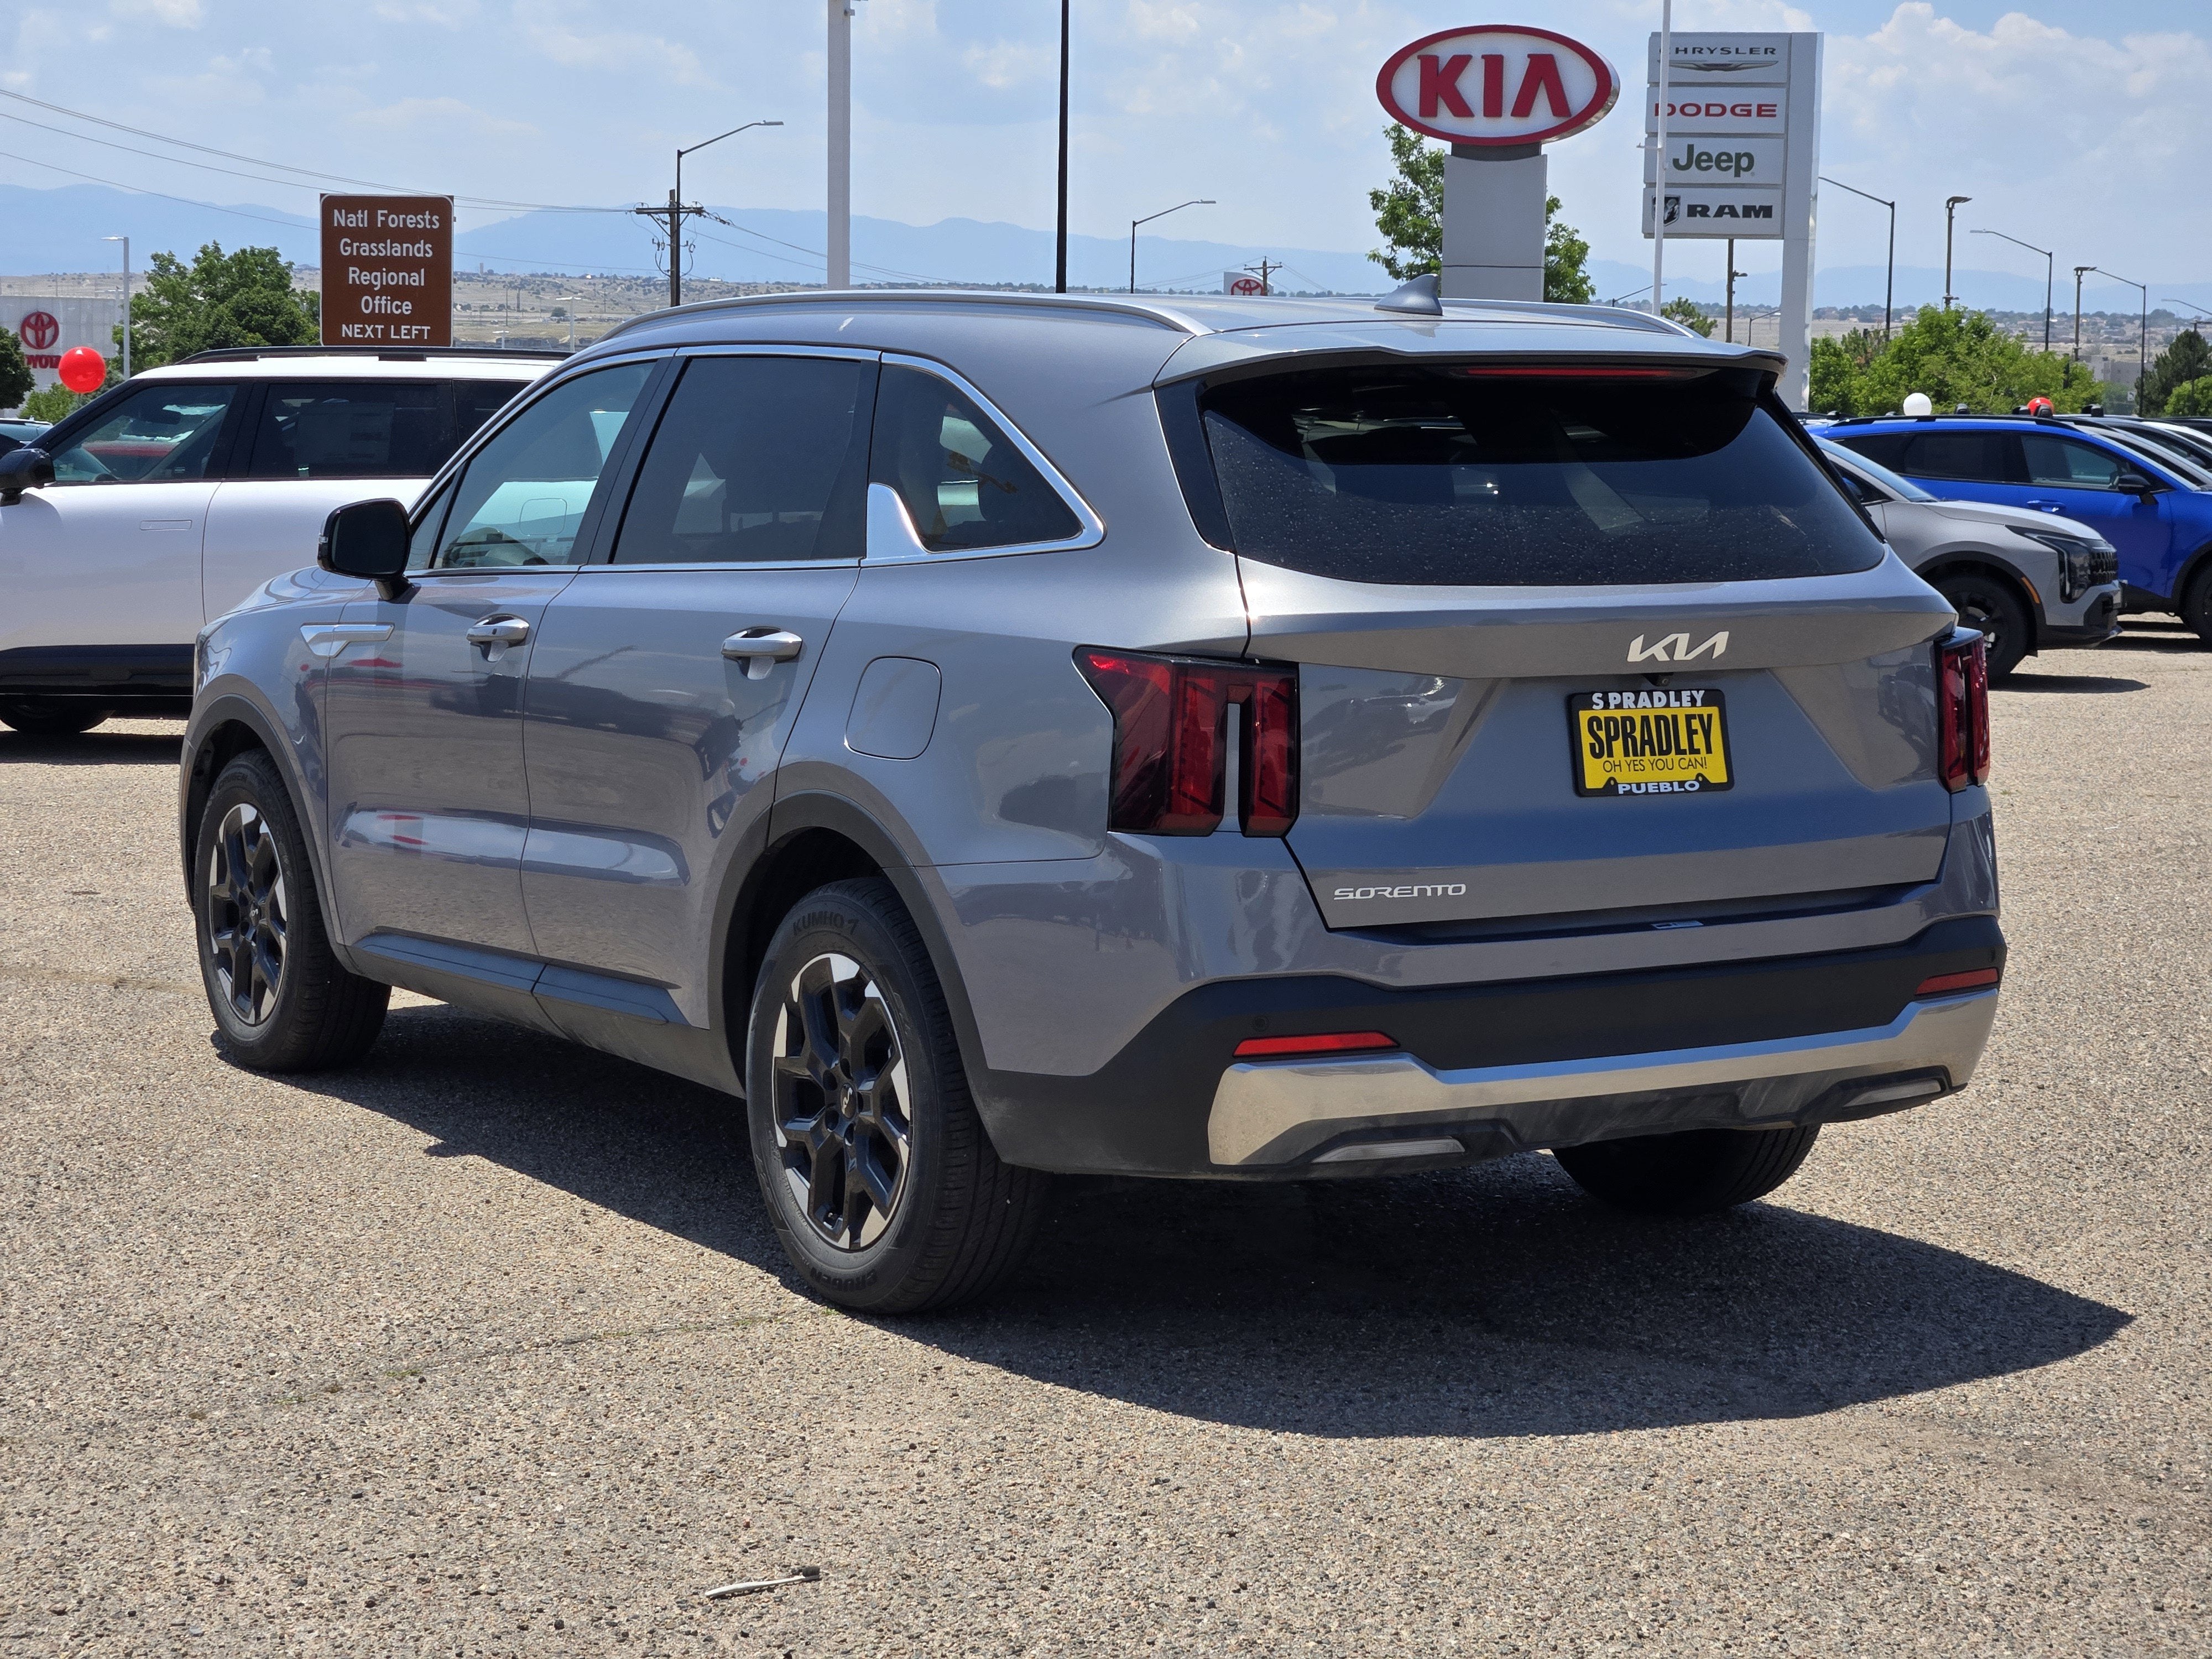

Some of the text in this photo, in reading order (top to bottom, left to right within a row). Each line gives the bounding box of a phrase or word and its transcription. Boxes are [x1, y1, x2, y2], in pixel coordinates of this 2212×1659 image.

[1659, 46, 1776, 55] HRYSLER
[1417, 53, 1572, 118] KIA
[1654, 103, 1777, 117] DODGE
[1672, 144, 1754, 178] Jeep
[333, 209, 440, 229] Natl Forests
[1687, 204, 1772, 218] RAM
[340, 238, 433, 257] Grasslands
[348, 267, 425, 290] Regional
[361, 295, 412, 315] Office
[342, 324, 431, 340] NEXT LEFT
[1587, 713, 1713, 759] SPRADLEY
[1603, 757, 1707, 773] OH YES YOU CAN!
[1618, 780, 1700, 794] PUEBLO
[1334, 884, 1466, 900] SORENTO
[792, 911, 845, 936] KUMHO
